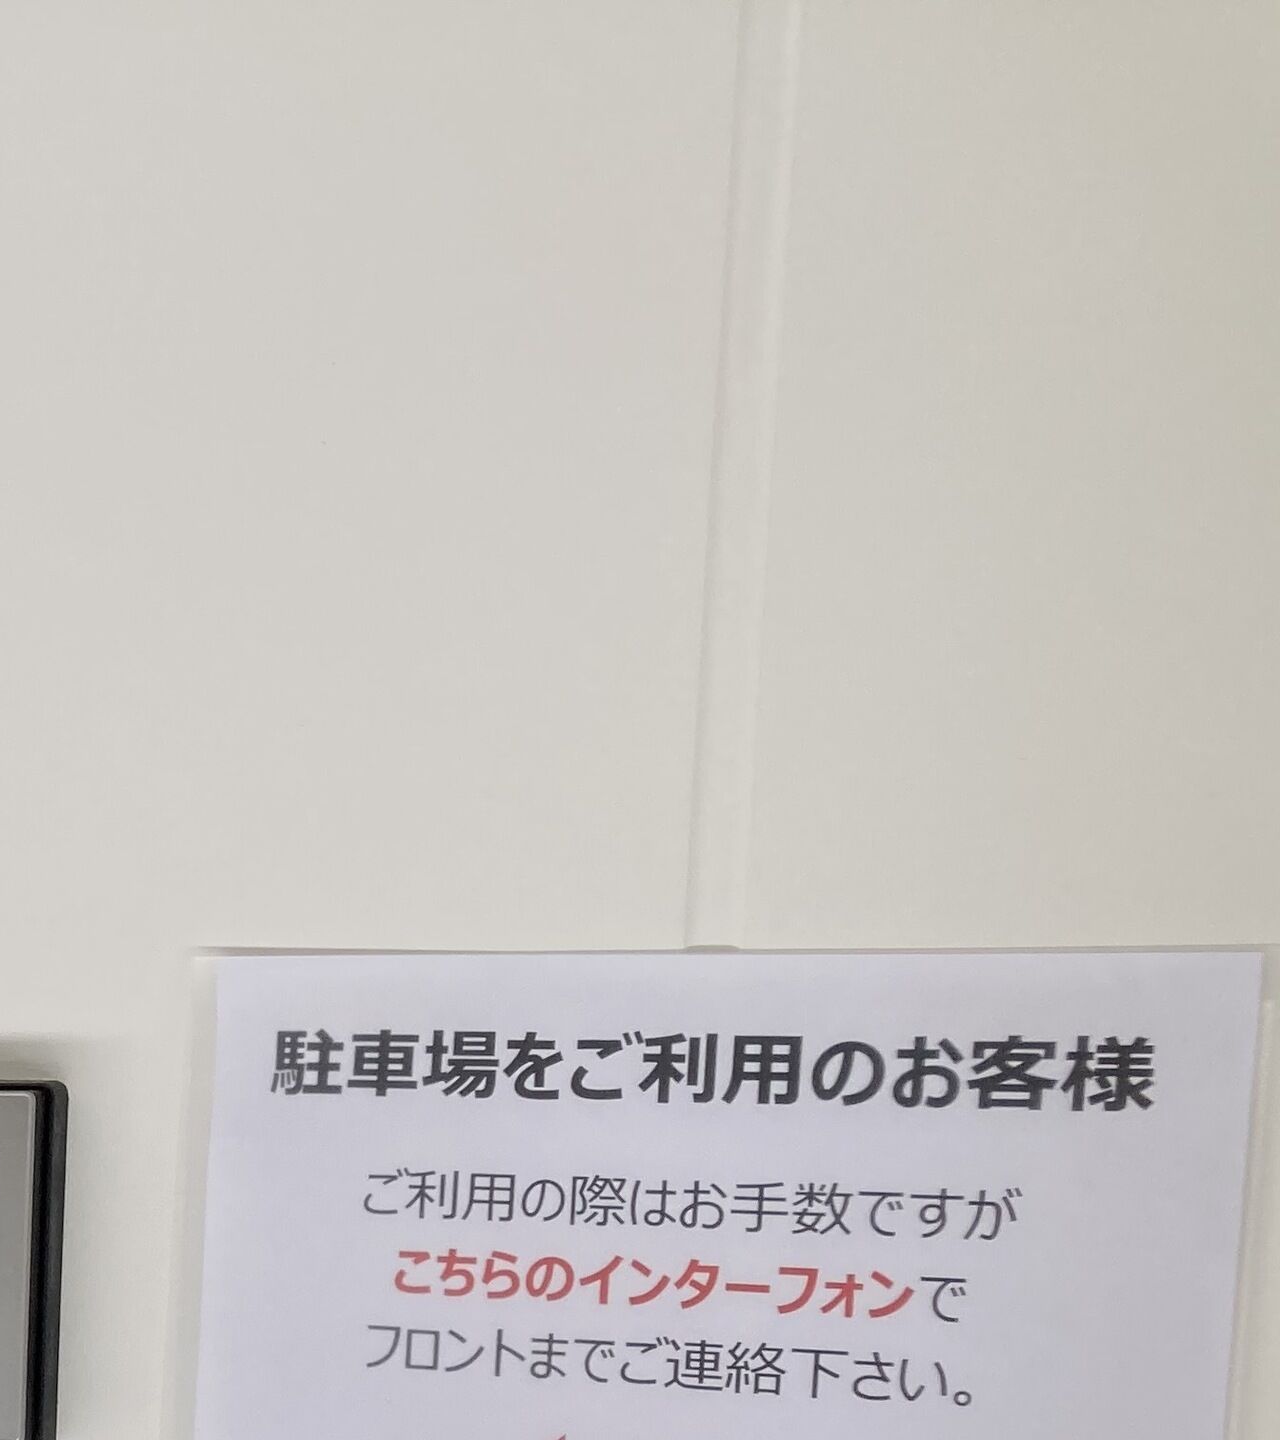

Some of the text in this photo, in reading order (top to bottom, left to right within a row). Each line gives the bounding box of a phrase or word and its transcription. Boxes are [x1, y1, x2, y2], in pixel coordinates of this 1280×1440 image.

[271, 1029, 1155, 1111] 駐車場をご利用のお客様
[364, 1168, 1022, 1240] ご利用の際はお手数ですが
[394, 1249, 966, 1323] こちらのインターフォンで
[366, 1325, 972, 1407] フロントまでご連絡下さい。
